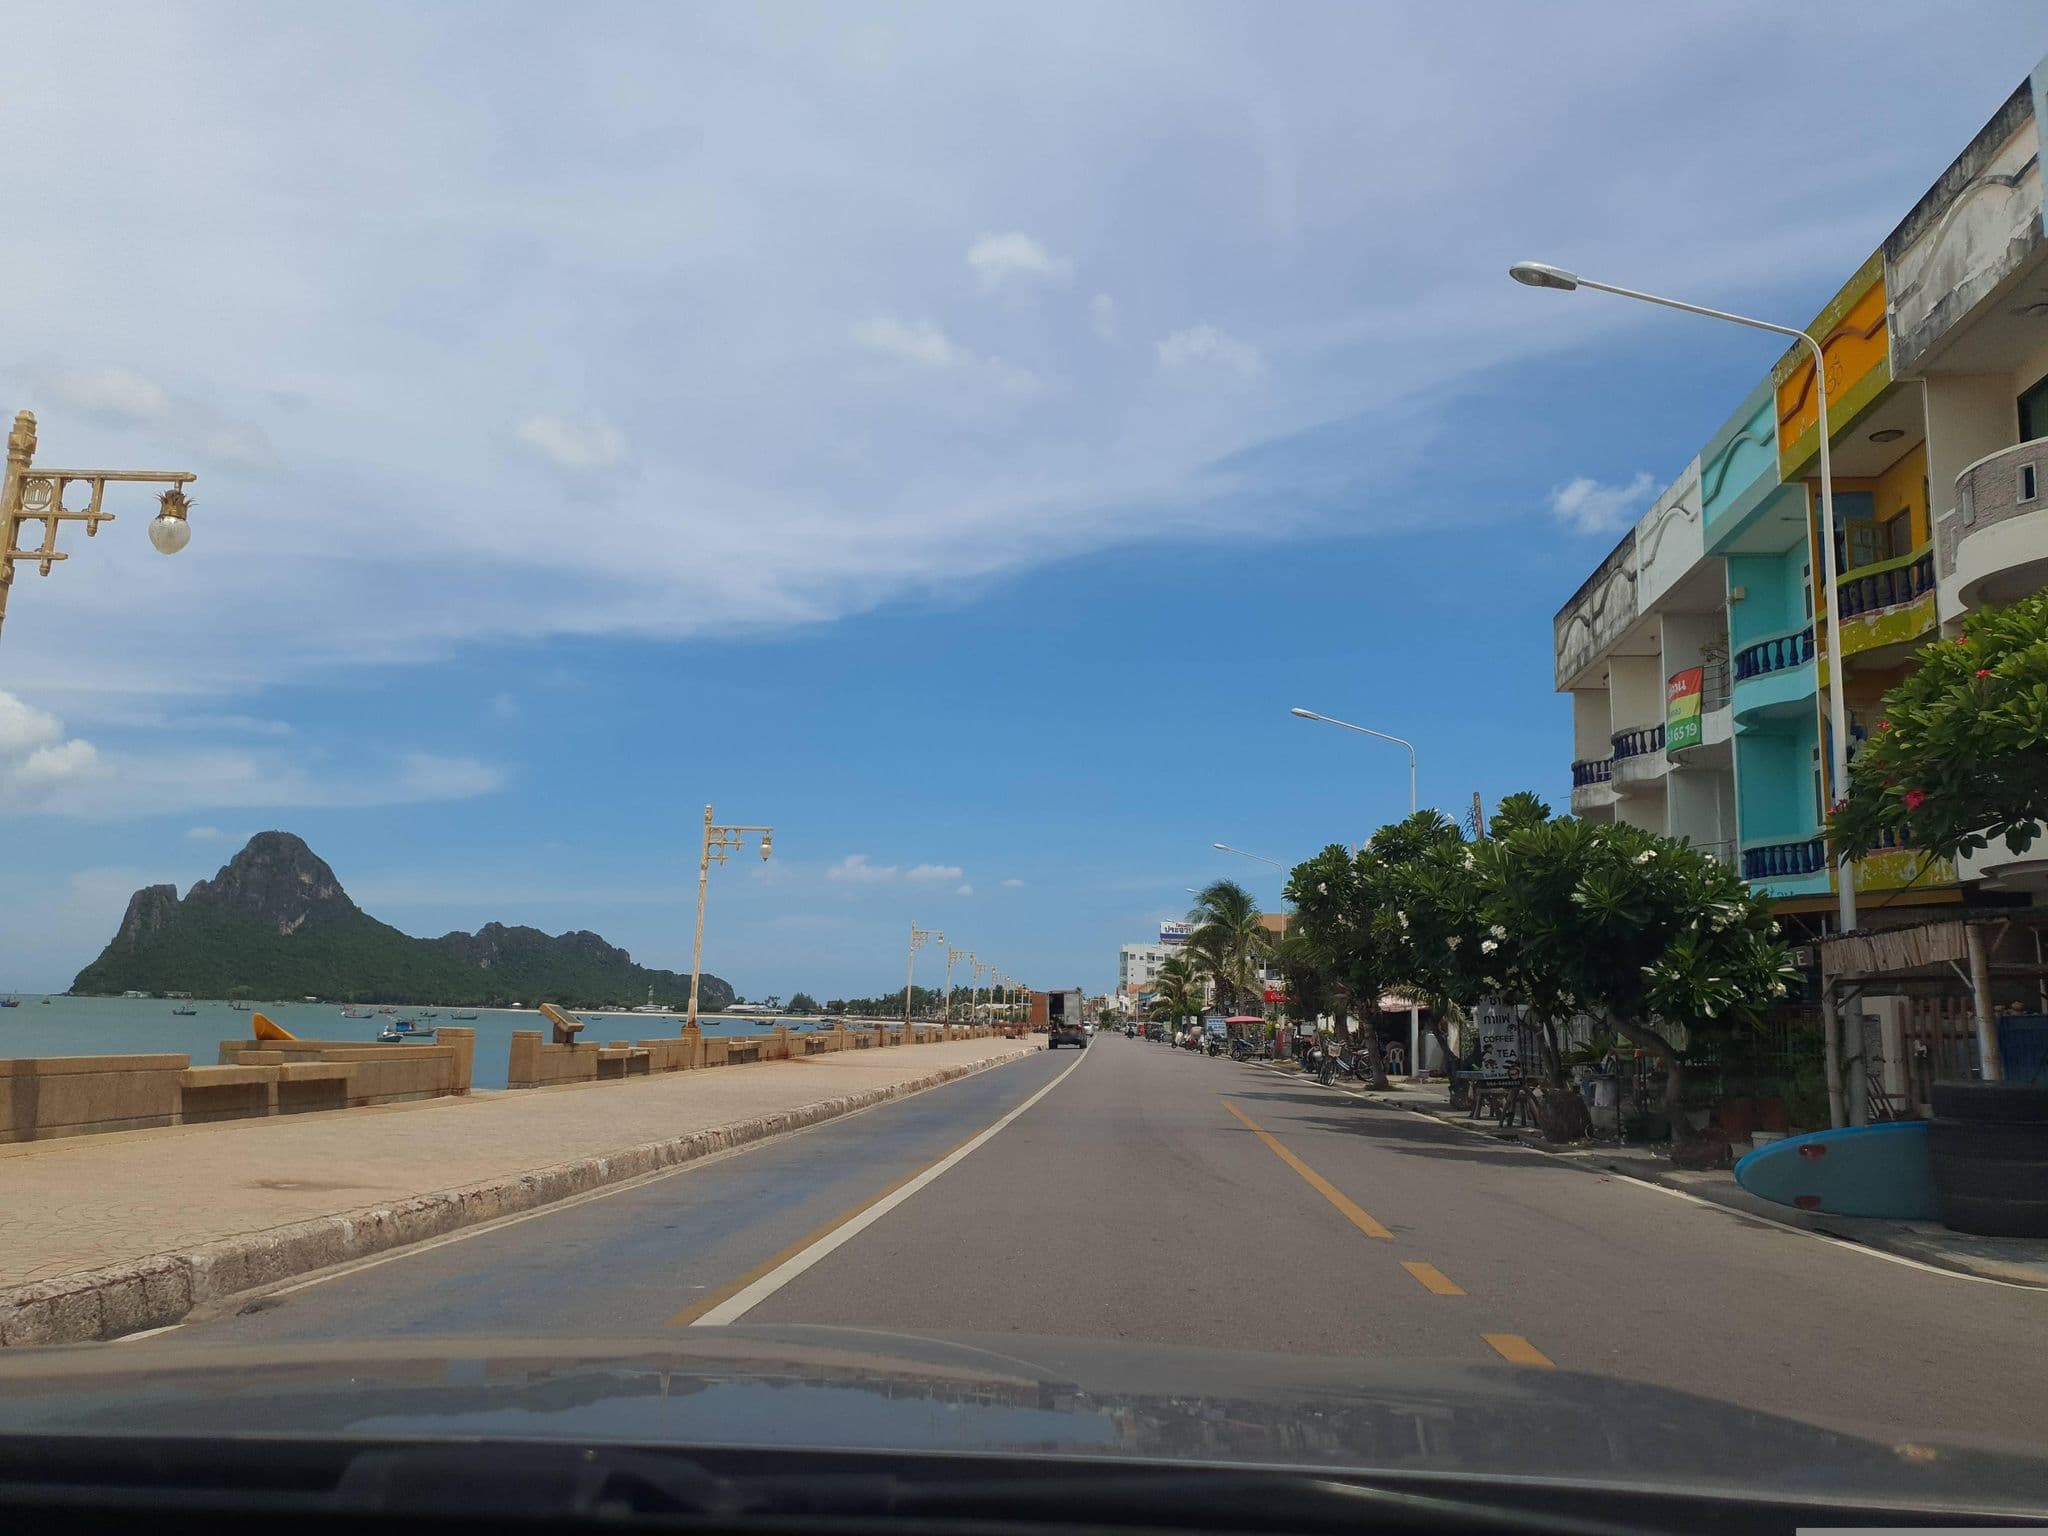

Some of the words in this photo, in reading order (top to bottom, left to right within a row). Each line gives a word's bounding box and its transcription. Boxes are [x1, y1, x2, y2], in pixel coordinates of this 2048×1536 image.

[1483, 1013, 1510, 1025] กาแฟ
[1483, 1035, 1515, 1043] COFFEE
[1496, 1049, 1517, 1058] TEA
